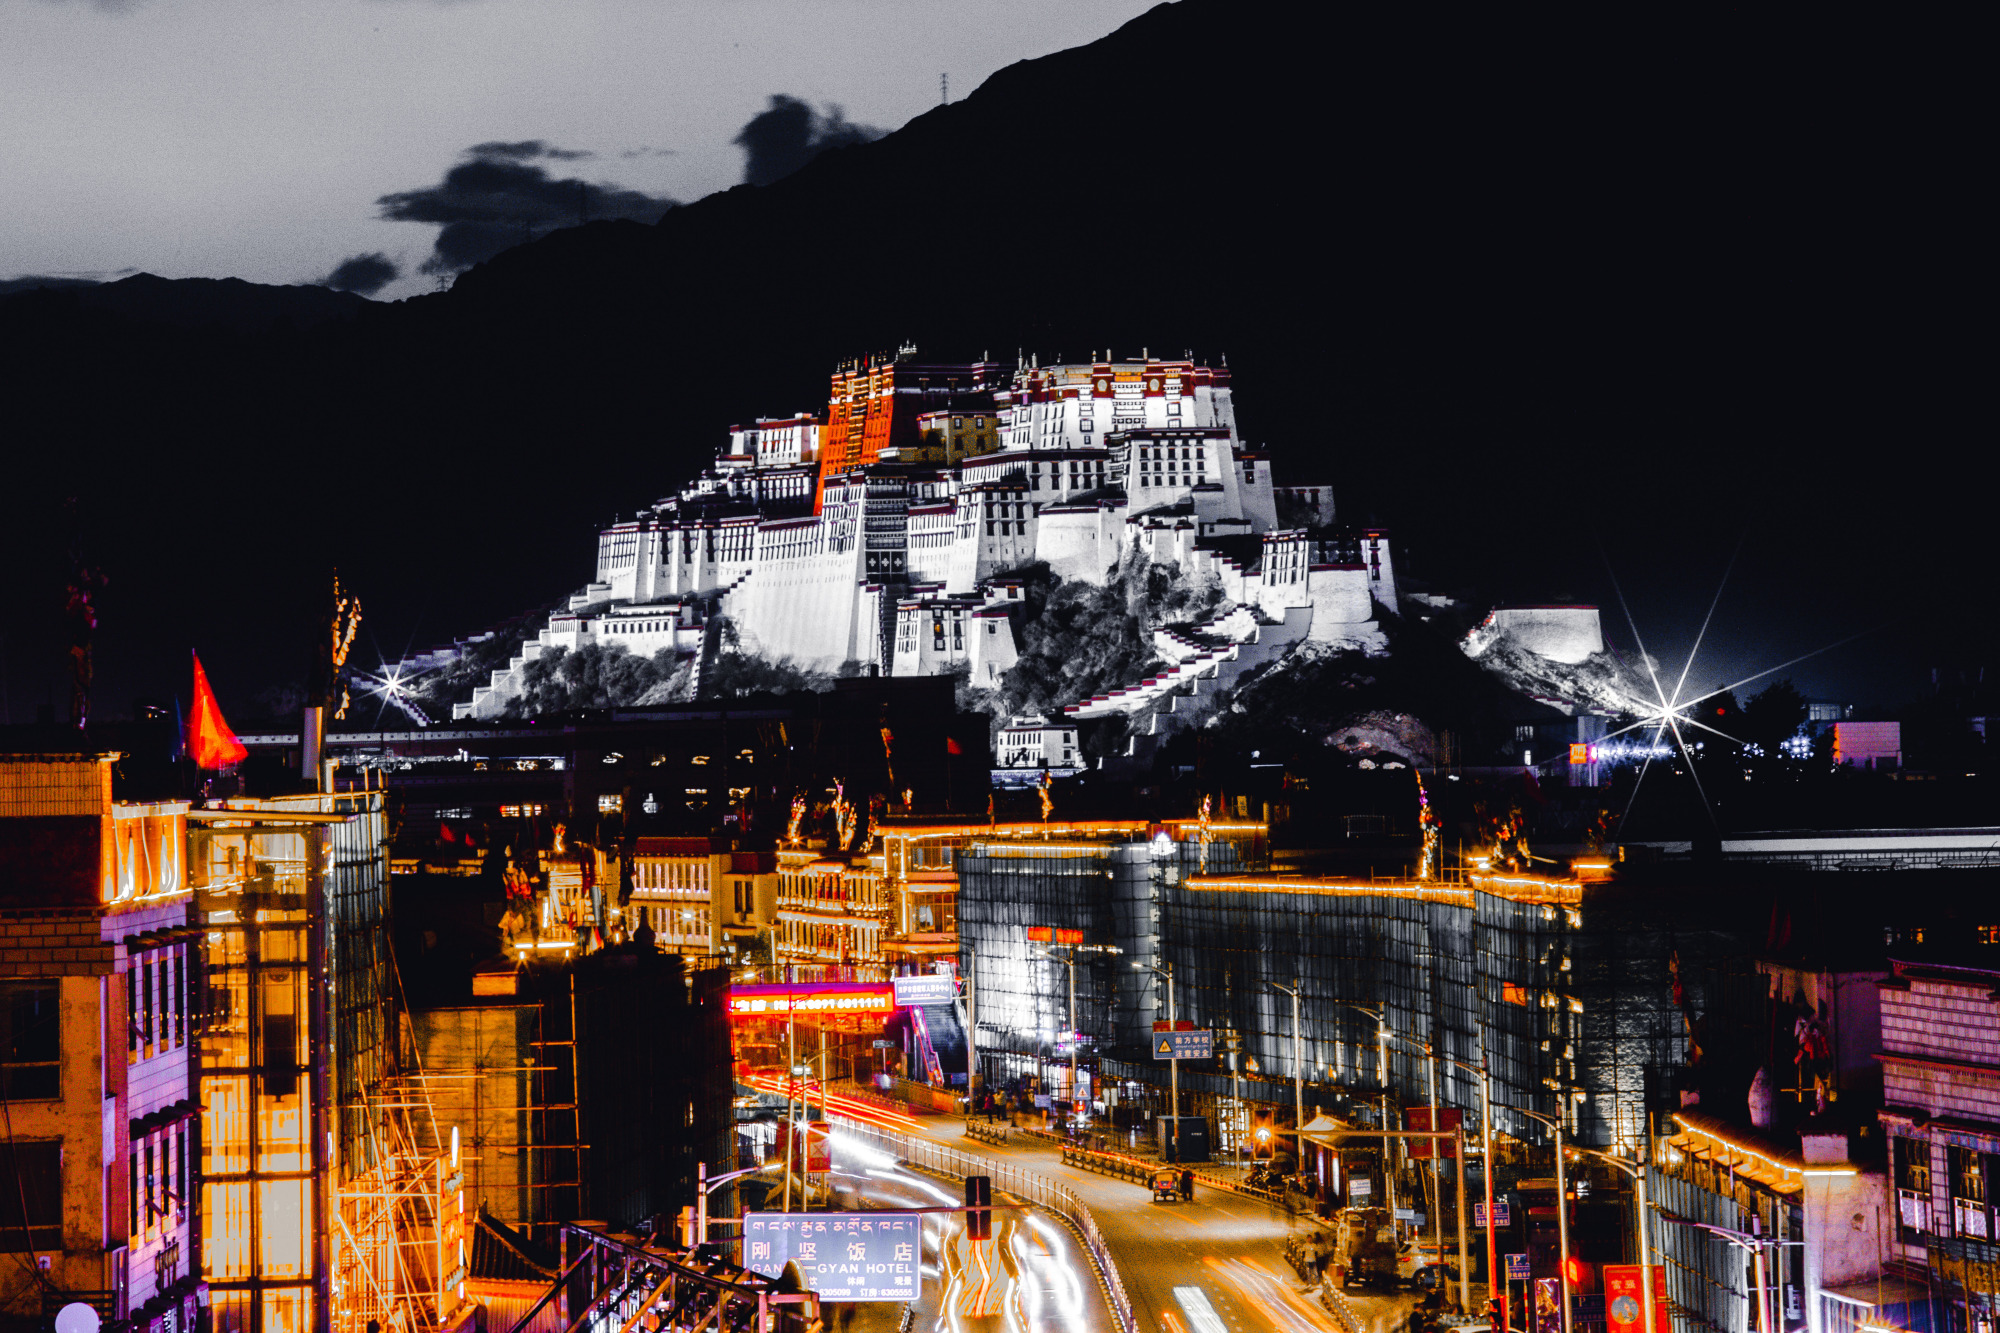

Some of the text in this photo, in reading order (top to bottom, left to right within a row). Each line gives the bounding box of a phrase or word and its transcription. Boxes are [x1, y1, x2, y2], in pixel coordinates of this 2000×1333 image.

[751, 1241, 913, 1262] 刚坚饭店
[866, 1264, 913, 1274] HOTEL
